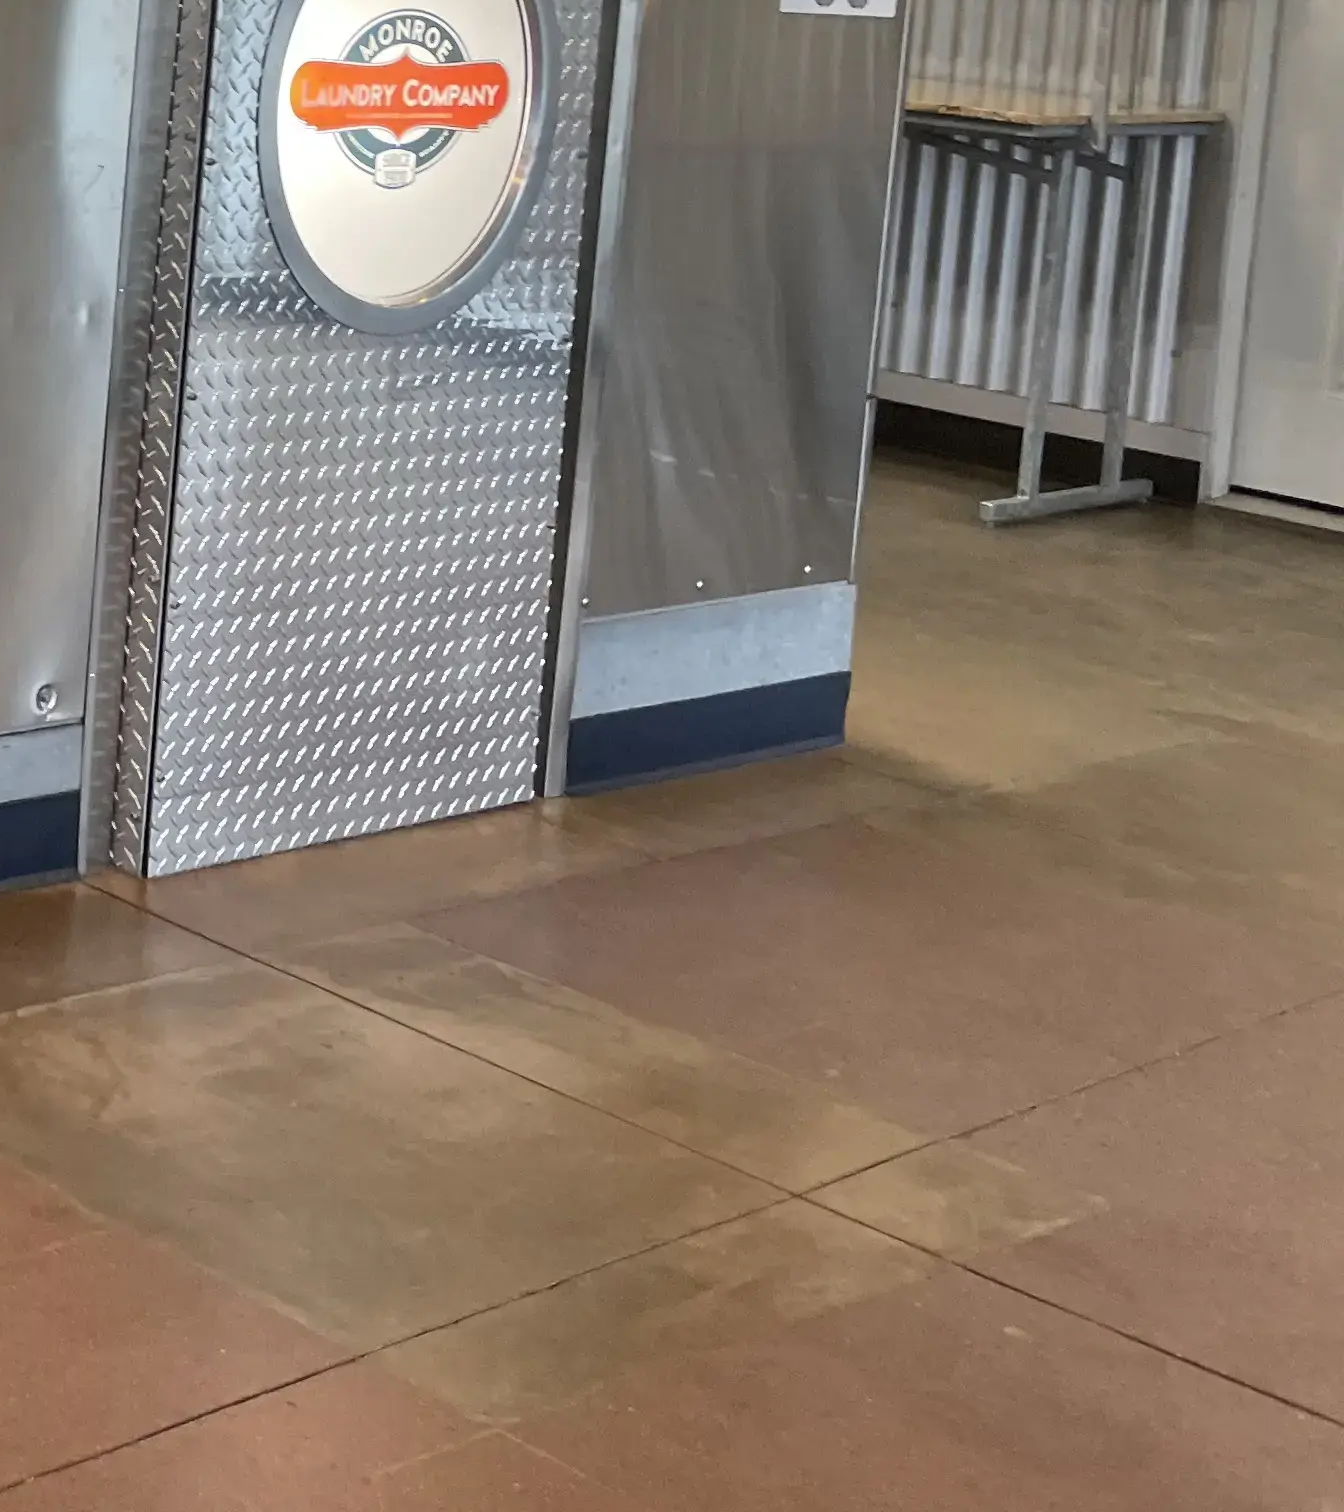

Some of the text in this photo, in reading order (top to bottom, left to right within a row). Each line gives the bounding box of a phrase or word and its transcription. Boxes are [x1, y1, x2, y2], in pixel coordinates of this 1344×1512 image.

[359, 19, 454, 62] MONROE
[301, 79, 500, 109] LAUNDRY COMPANY
